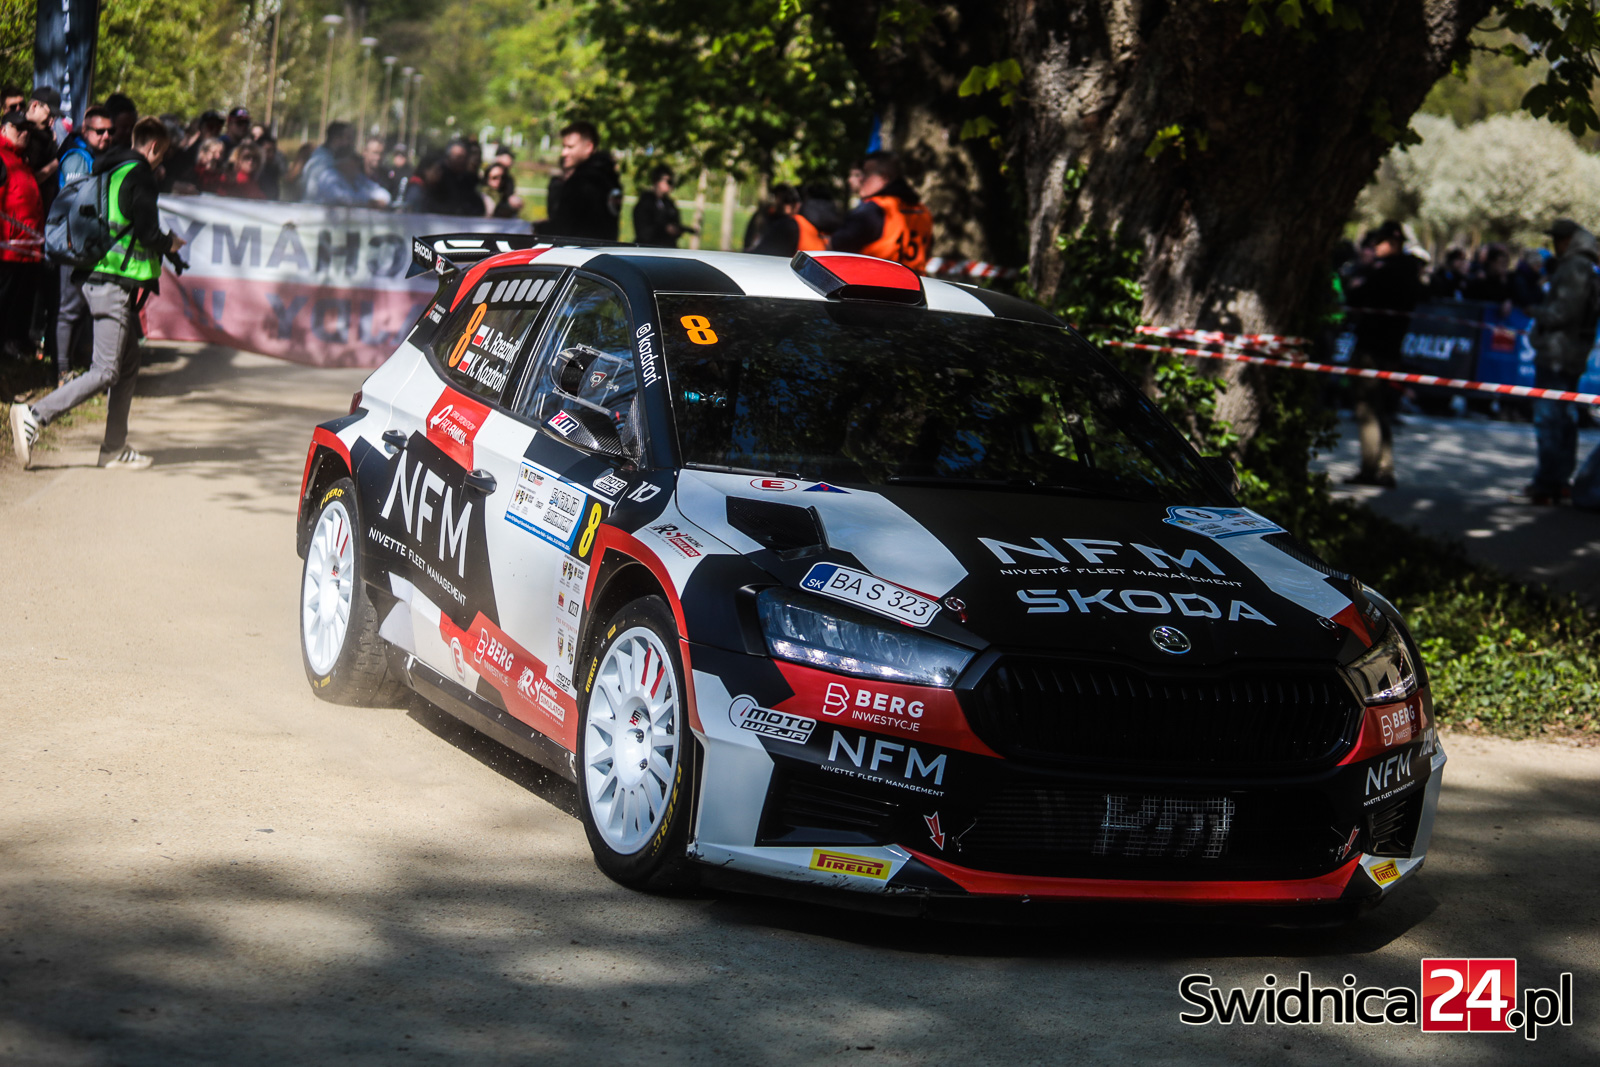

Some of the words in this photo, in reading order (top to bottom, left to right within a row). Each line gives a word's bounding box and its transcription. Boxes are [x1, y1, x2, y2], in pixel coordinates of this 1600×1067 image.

[413, 240, 433, 258] SKODA
[448, 302, 488, 368] 8
[680, 314, 719, 346] 8
[466, 353, 482, 378] K.
[474, 358, 510, 393] Kozdroń
[602, 475, 627, 489] MOTO
[381, 448, 473, 579] NFM
[578, 502, 602, 558] 8
[368, 526, 407, 557] NIVETTE
[408, 548, 427, 571] FLEET
[426, 563, 467, 607] MANAGEMENT
[976, 536, 1227, 577] NFM
[999, 565, 1071, 576] NIVETTE
[1075, 567, 1127, 576] FLEET
[1132, 569, 1244, 588] MANAGEMENT
[807, 578, 825, 590] SK
[830, 573, 863, 596] BA
[866, 584, 886, 602] S
[887, 590, 931, 617] 323
[487, 637, 515, 672] BERG
[540, 693, 564, 718] SIMULATOR
[541, 681, 558, 700] RACING
[855, 689, 925, 719] BERG
[741, 719, 810, 742] WIZJA
[746, 708, 816, 731] MOTO
[851, 709, 921, 733] INWESTYCJE
[1392, 703, 1416, 730] BERG
[827, 729, 948, 786] NFM
[1364, 748, 1413, 796] NFM
[820, 764, 855, 778] NIVETTE
[857, 772, 883, 784] FLEET
[885, 778, 945, 798] MANAGEMENT
[1363, 793, 1381, 807] NIVETTE
[1380, 788, 1394, 801] FLEET
[1392, 779, 1416, 797] MANAGEMENT
[816, 852, 885, 877] PIRELLI
[1372, 861, 1400, 882] PIRELLI
